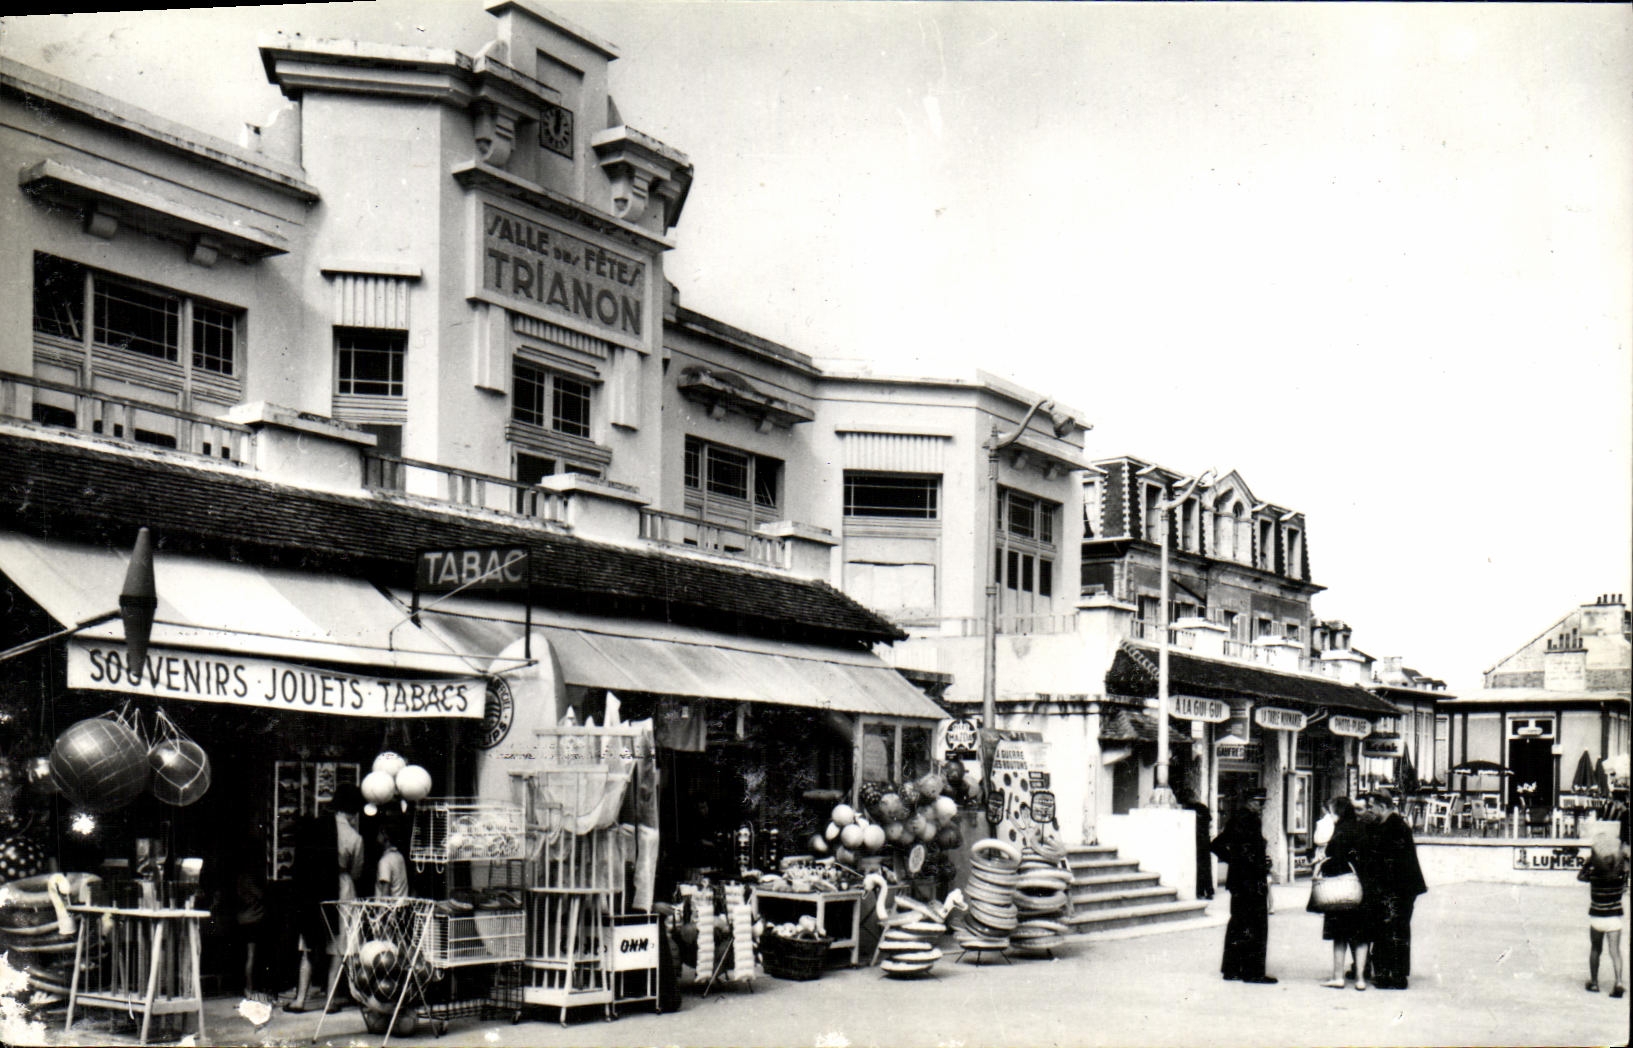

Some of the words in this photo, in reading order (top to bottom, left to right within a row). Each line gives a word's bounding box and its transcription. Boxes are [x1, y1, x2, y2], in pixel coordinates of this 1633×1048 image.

[488, 215, 549, 256] SALLE
[553, 248, 580, 266] DES
[488, 248, 640, 335] TRIANON
[424, 549, 524, 585] TABAC
[264, 668, 364, 710] JOUETS
[377, 681, 468, 713] TABACS
[1194, 699, 1207, 717] GUI
[1209, 701, 1222, 719] GUI
[1532, 856, 1586, 868] LUMIER
